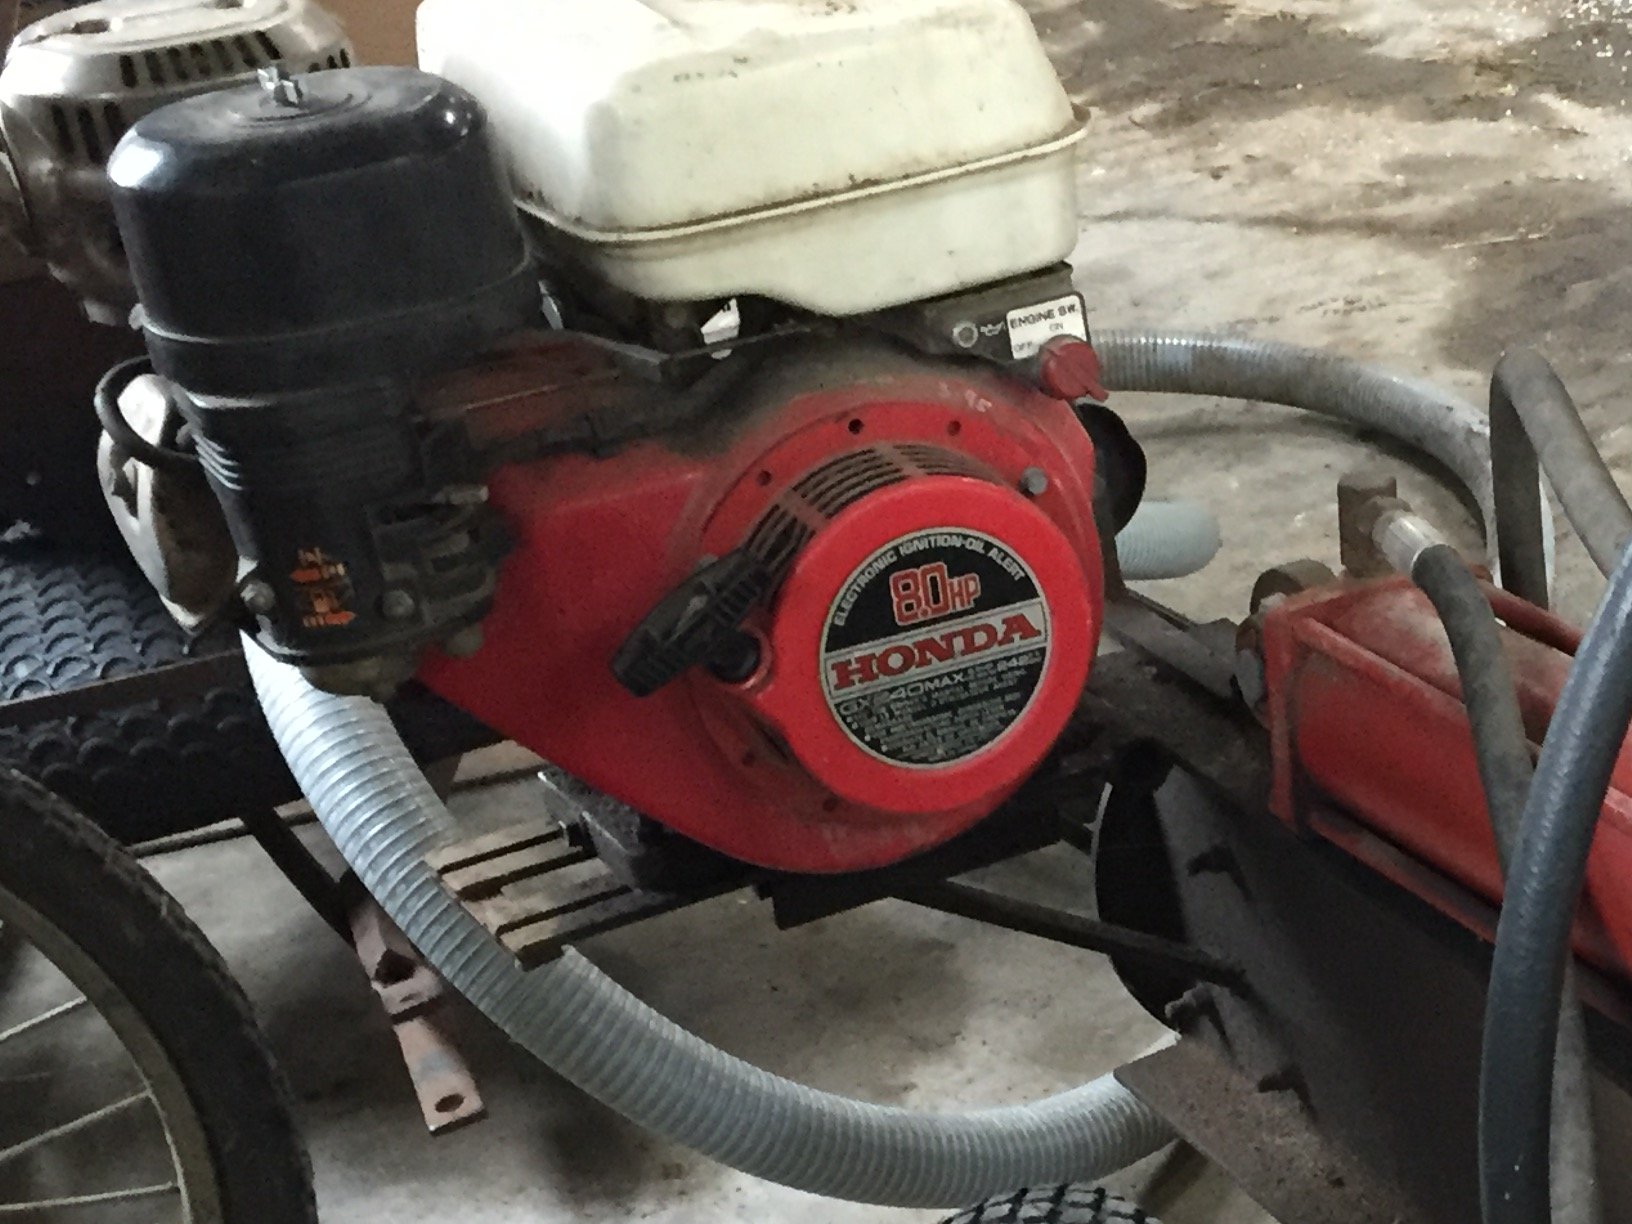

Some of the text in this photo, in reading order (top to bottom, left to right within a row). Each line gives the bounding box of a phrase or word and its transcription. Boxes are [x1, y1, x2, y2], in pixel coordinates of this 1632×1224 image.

[1009, 308, 1055, 329] ENGINE
[834, 550, 898, 627] ELECTRONIC
[987, 547, 1025, 581] ALERT
[831, 613, 1042, 691] HONDA
